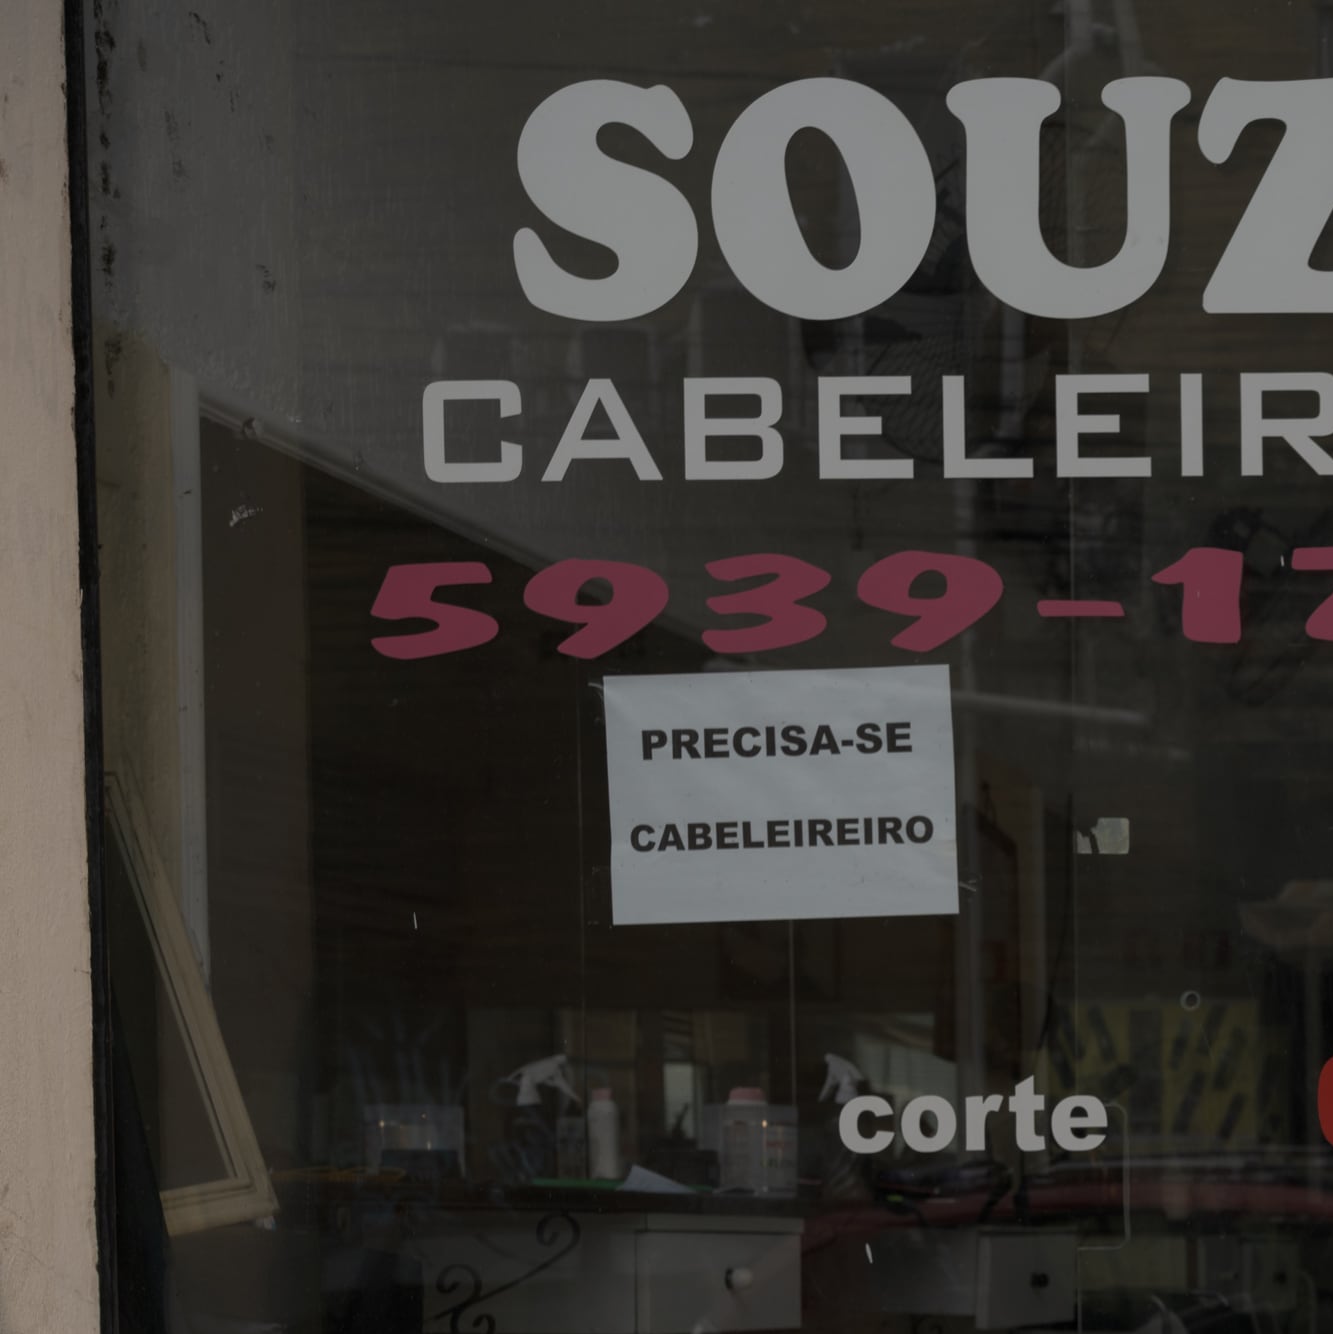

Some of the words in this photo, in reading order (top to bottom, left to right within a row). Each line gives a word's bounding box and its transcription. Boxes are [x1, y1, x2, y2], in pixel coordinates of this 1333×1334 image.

[641, 721, 913, 761] PRECISA-SE
[629, 814, 935, 854] CABELEIREIRO
[838, 1074, 1109, 1154] corte
